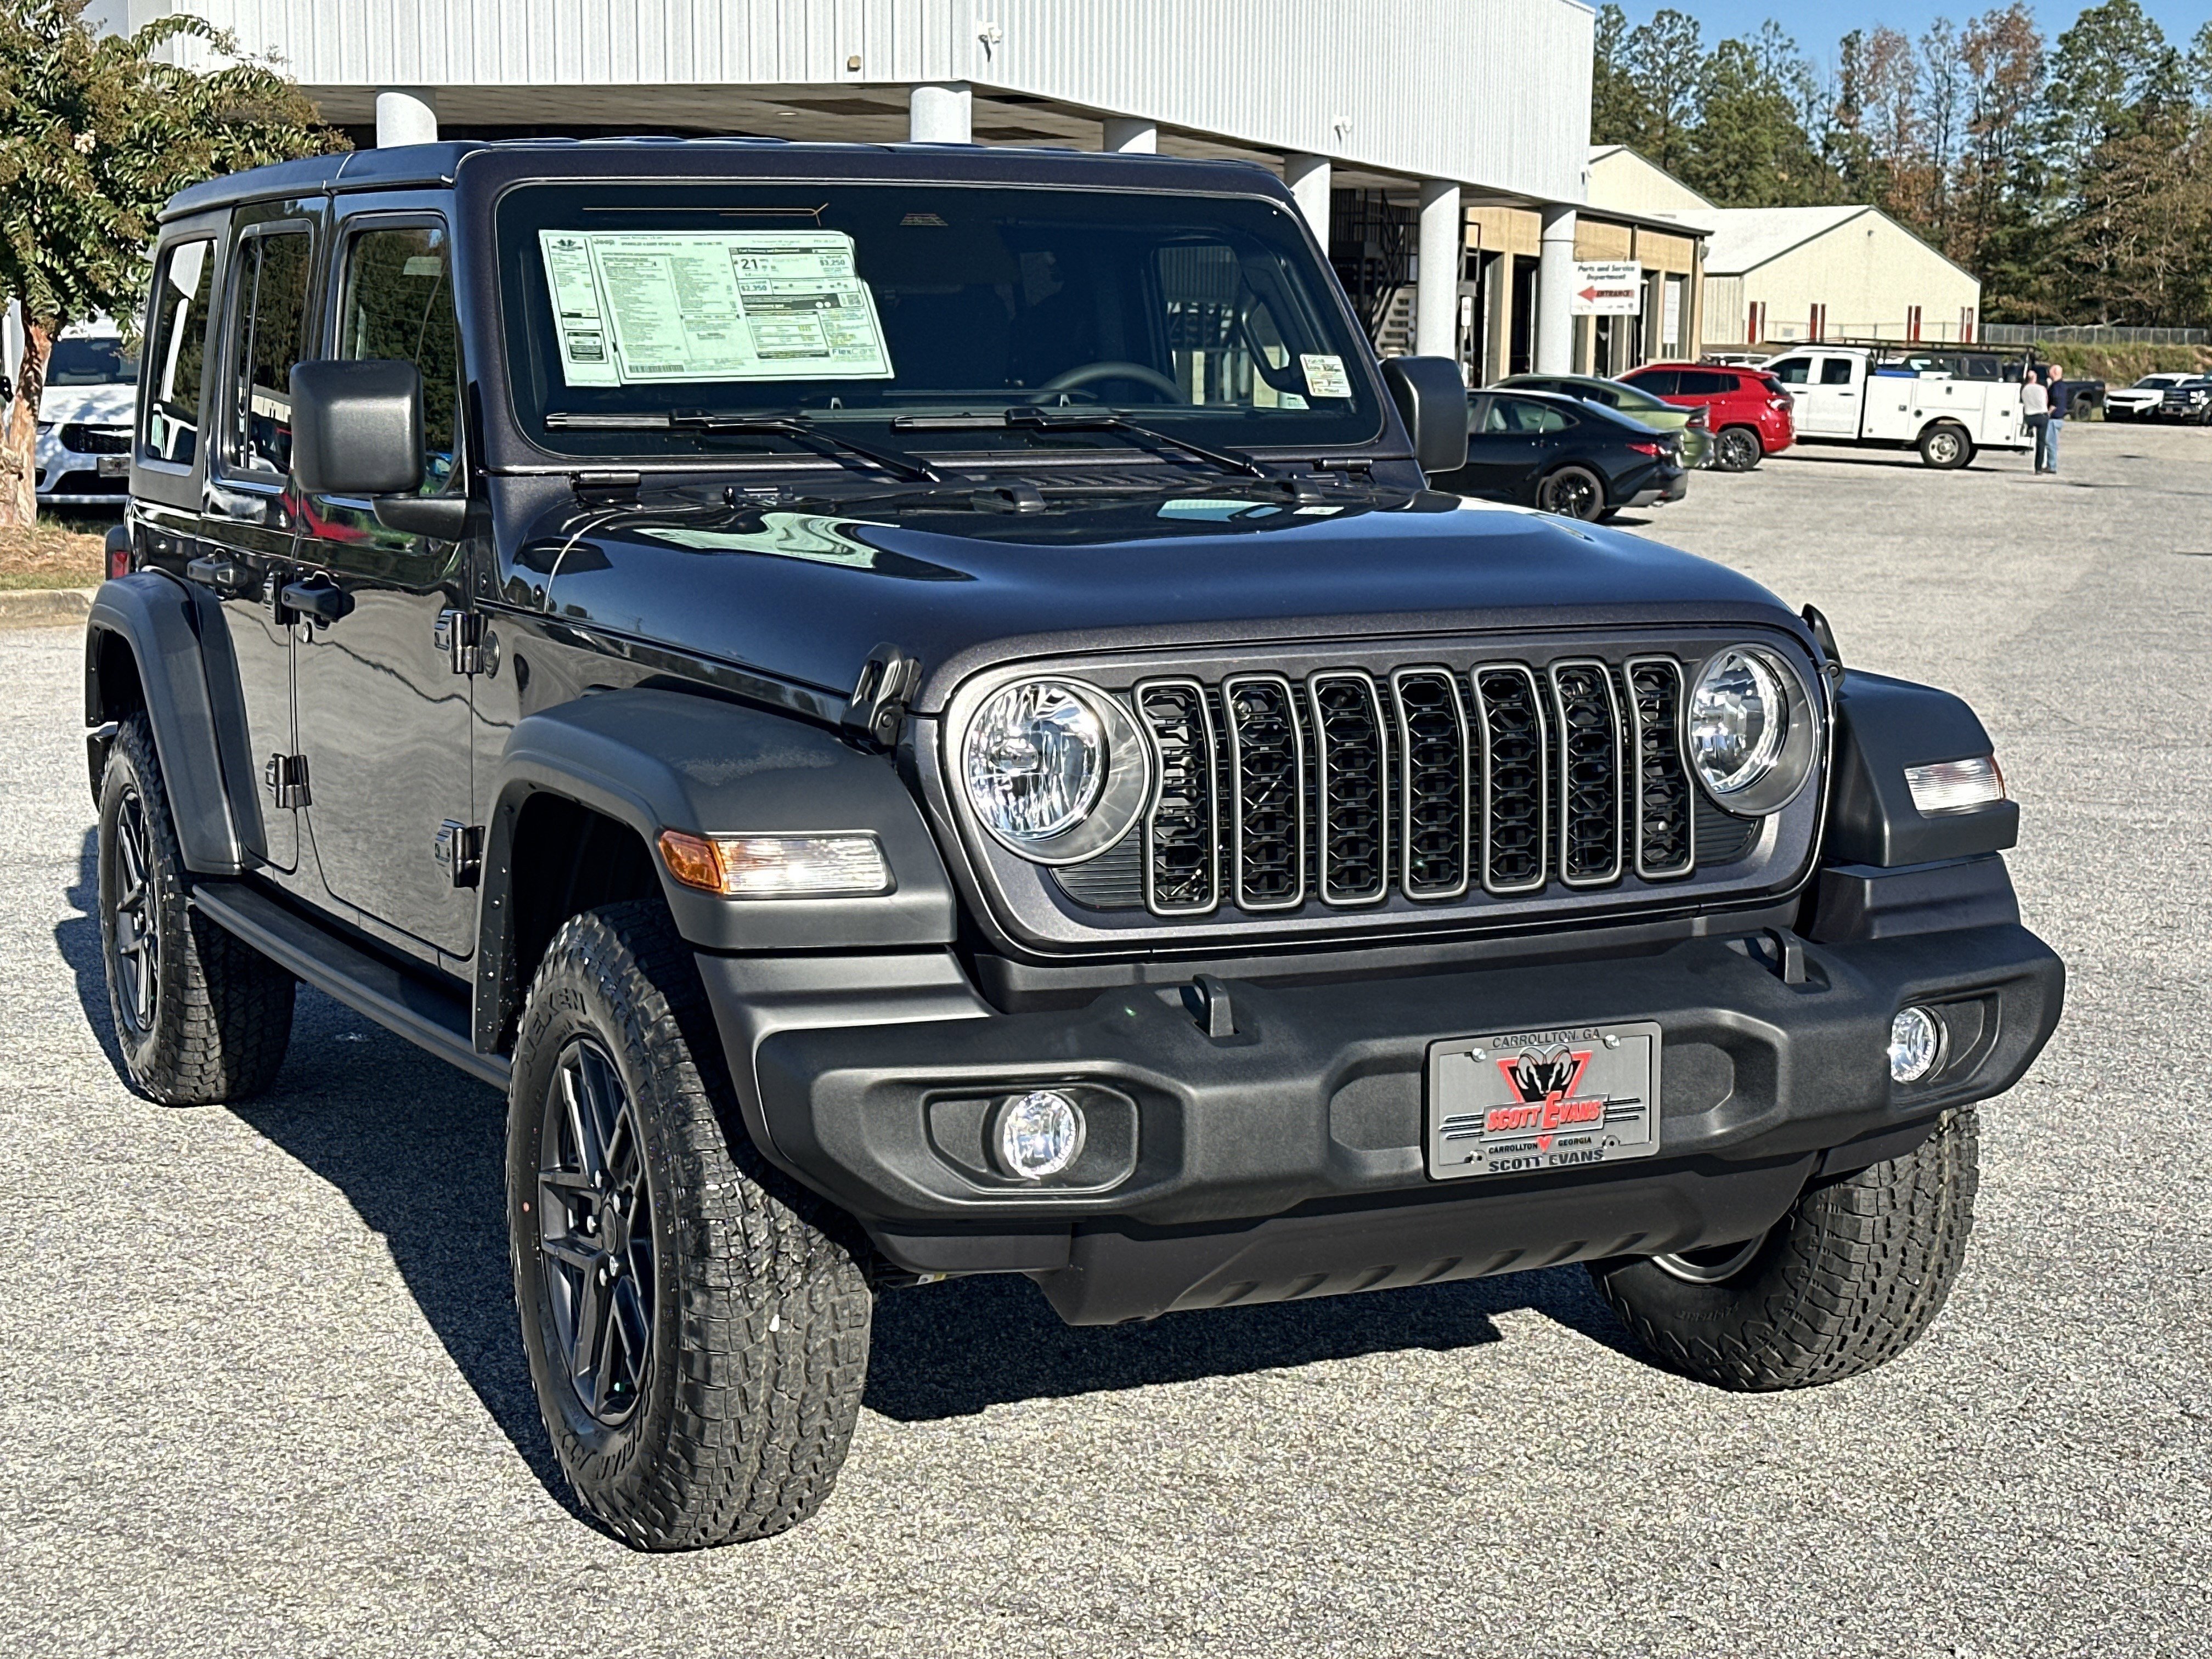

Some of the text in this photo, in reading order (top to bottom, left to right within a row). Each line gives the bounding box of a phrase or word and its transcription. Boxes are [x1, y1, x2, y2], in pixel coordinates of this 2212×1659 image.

[741, 258, 758, 269] 21
[1583, 1028, 1600, 1039] GA
[1486, 1090, 1601, 1132] SCOTT EVANS
[1488, 1136, 1592, 1154] CARROLLTON GEORGIA
[1488, 1149, 1604, 1172] SCOTT EVANS
